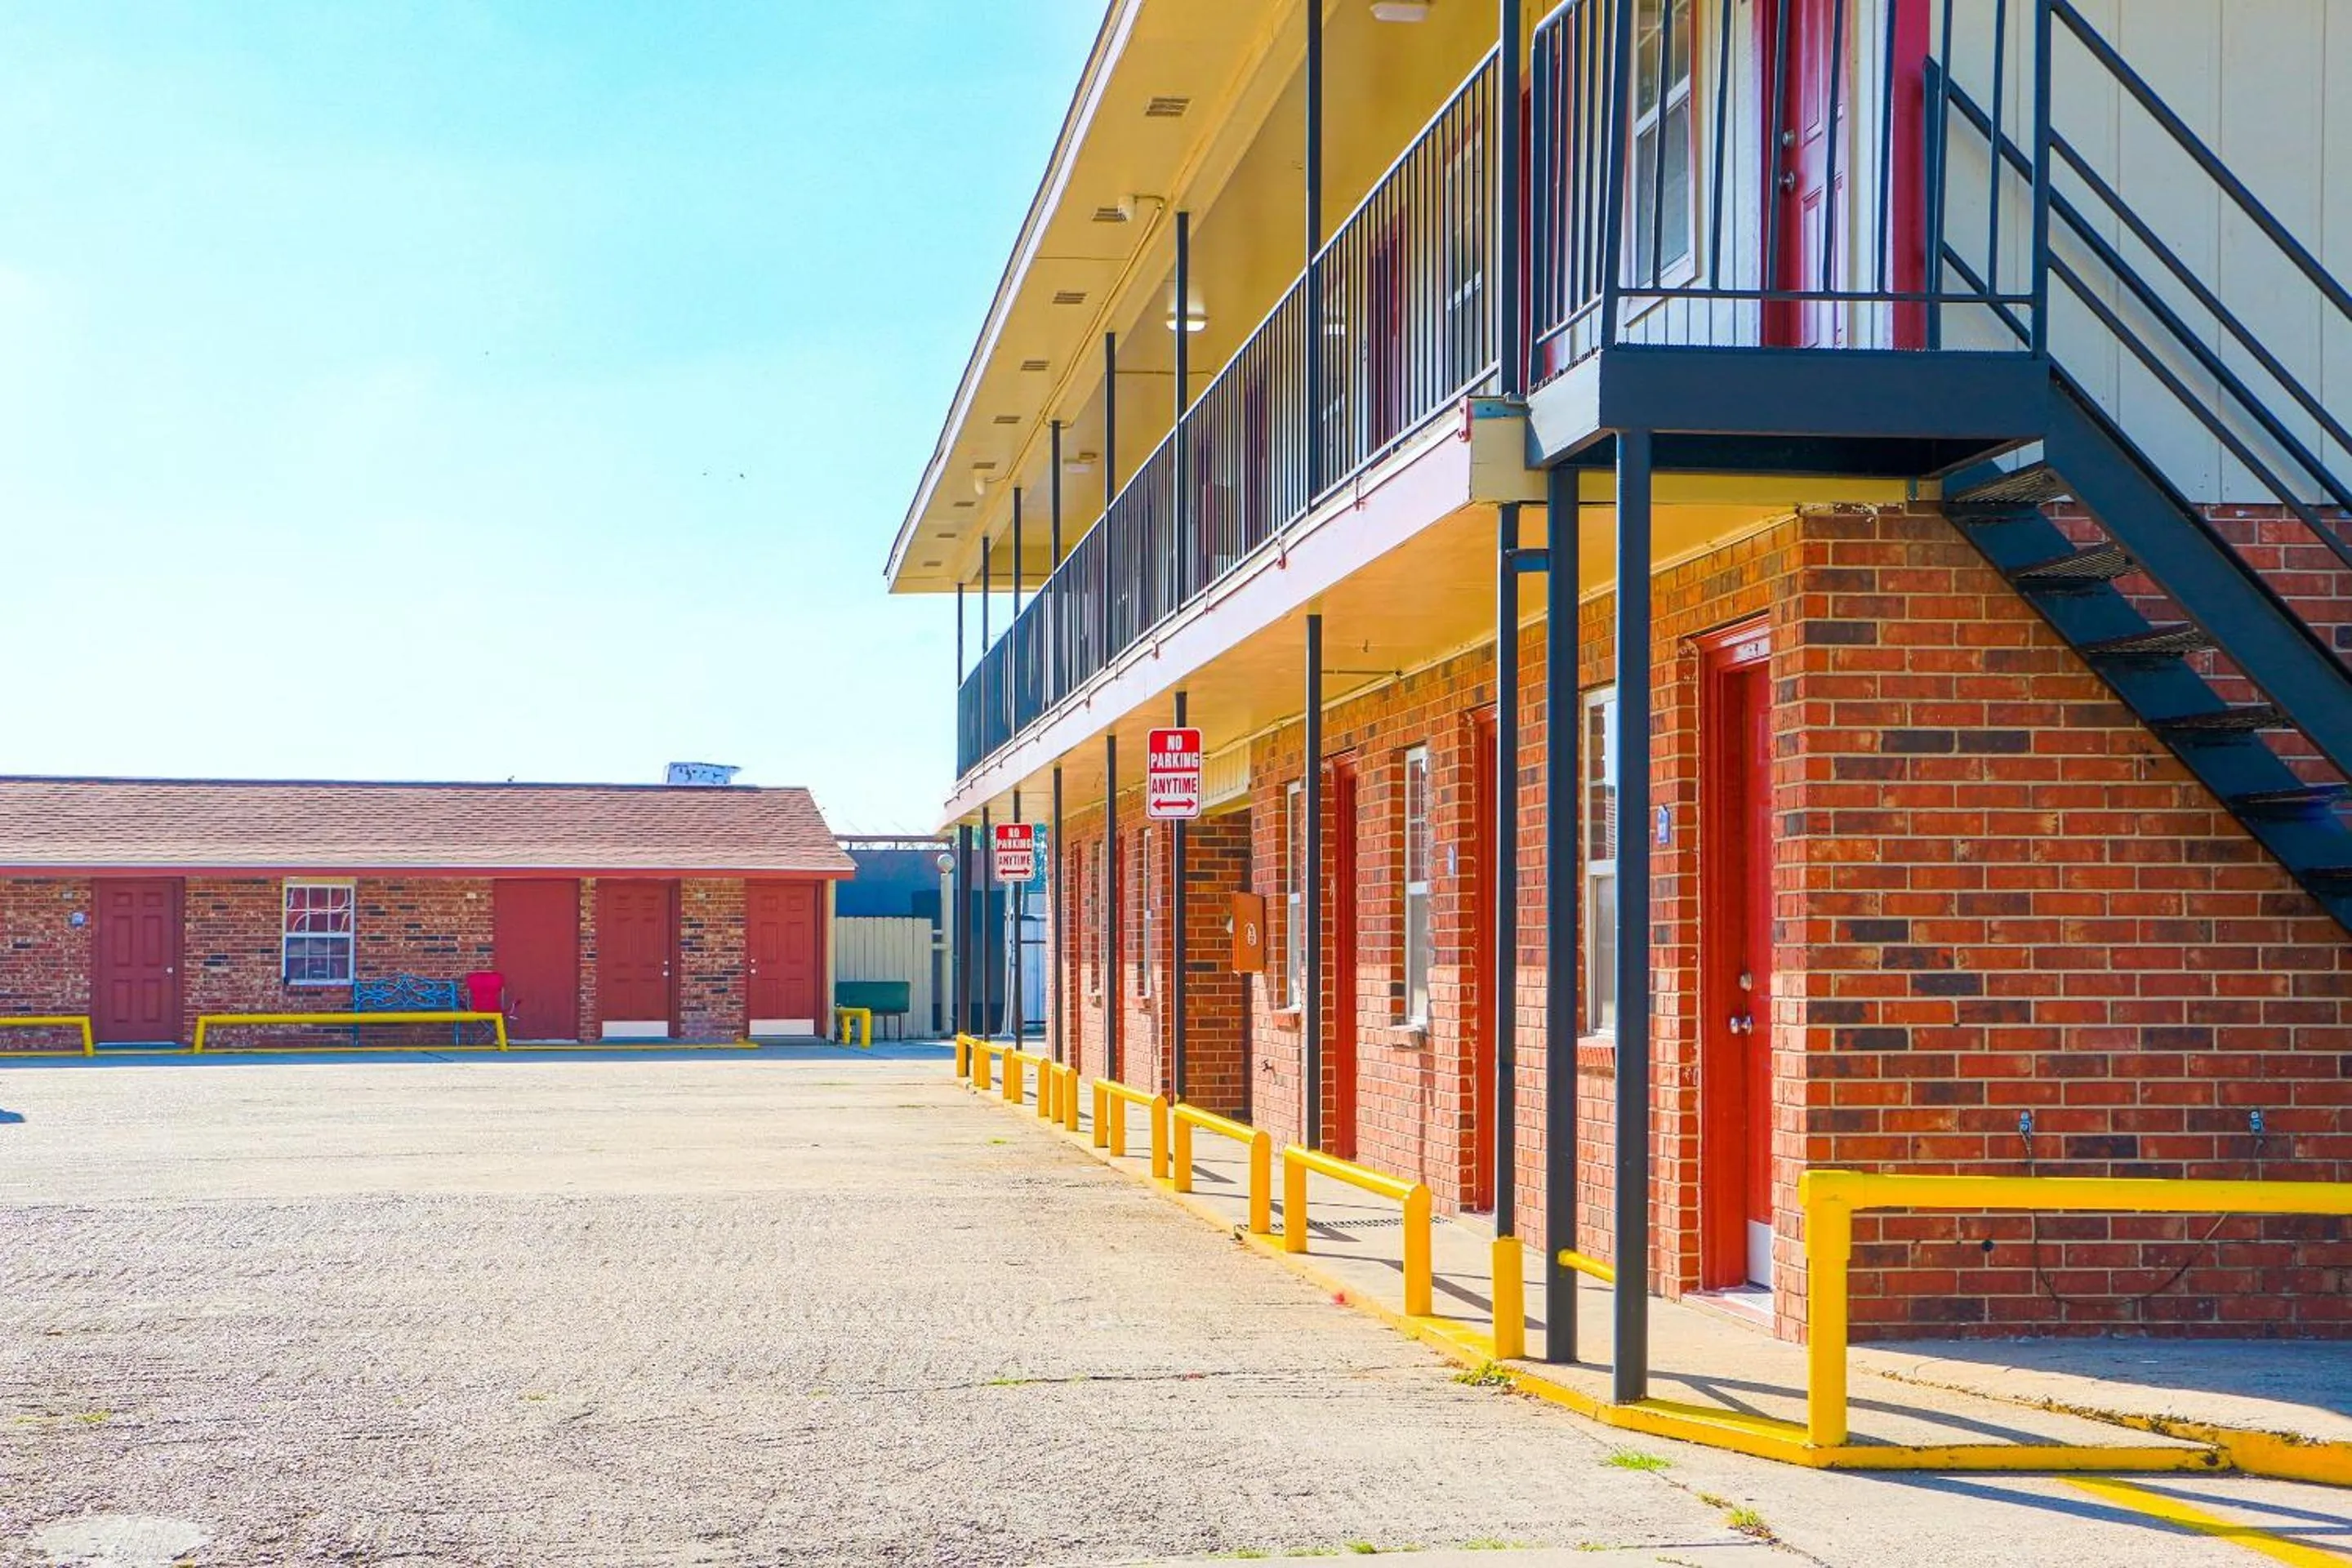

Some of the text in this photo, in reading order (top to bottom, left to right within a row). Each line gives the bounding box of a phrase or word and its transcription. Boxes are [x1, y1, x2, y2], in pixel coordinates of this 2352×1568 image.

[1167, 734, 1183, 751] NO
[1150, 752, 1200, 768] PARKING
[1152, 777, 1197, 794] ANYTIME
[1008, 827, 1020, 838] NO
[996, 839, 1032, 849] PARKING
[999, 855, 1031, 865] ANYTIME
